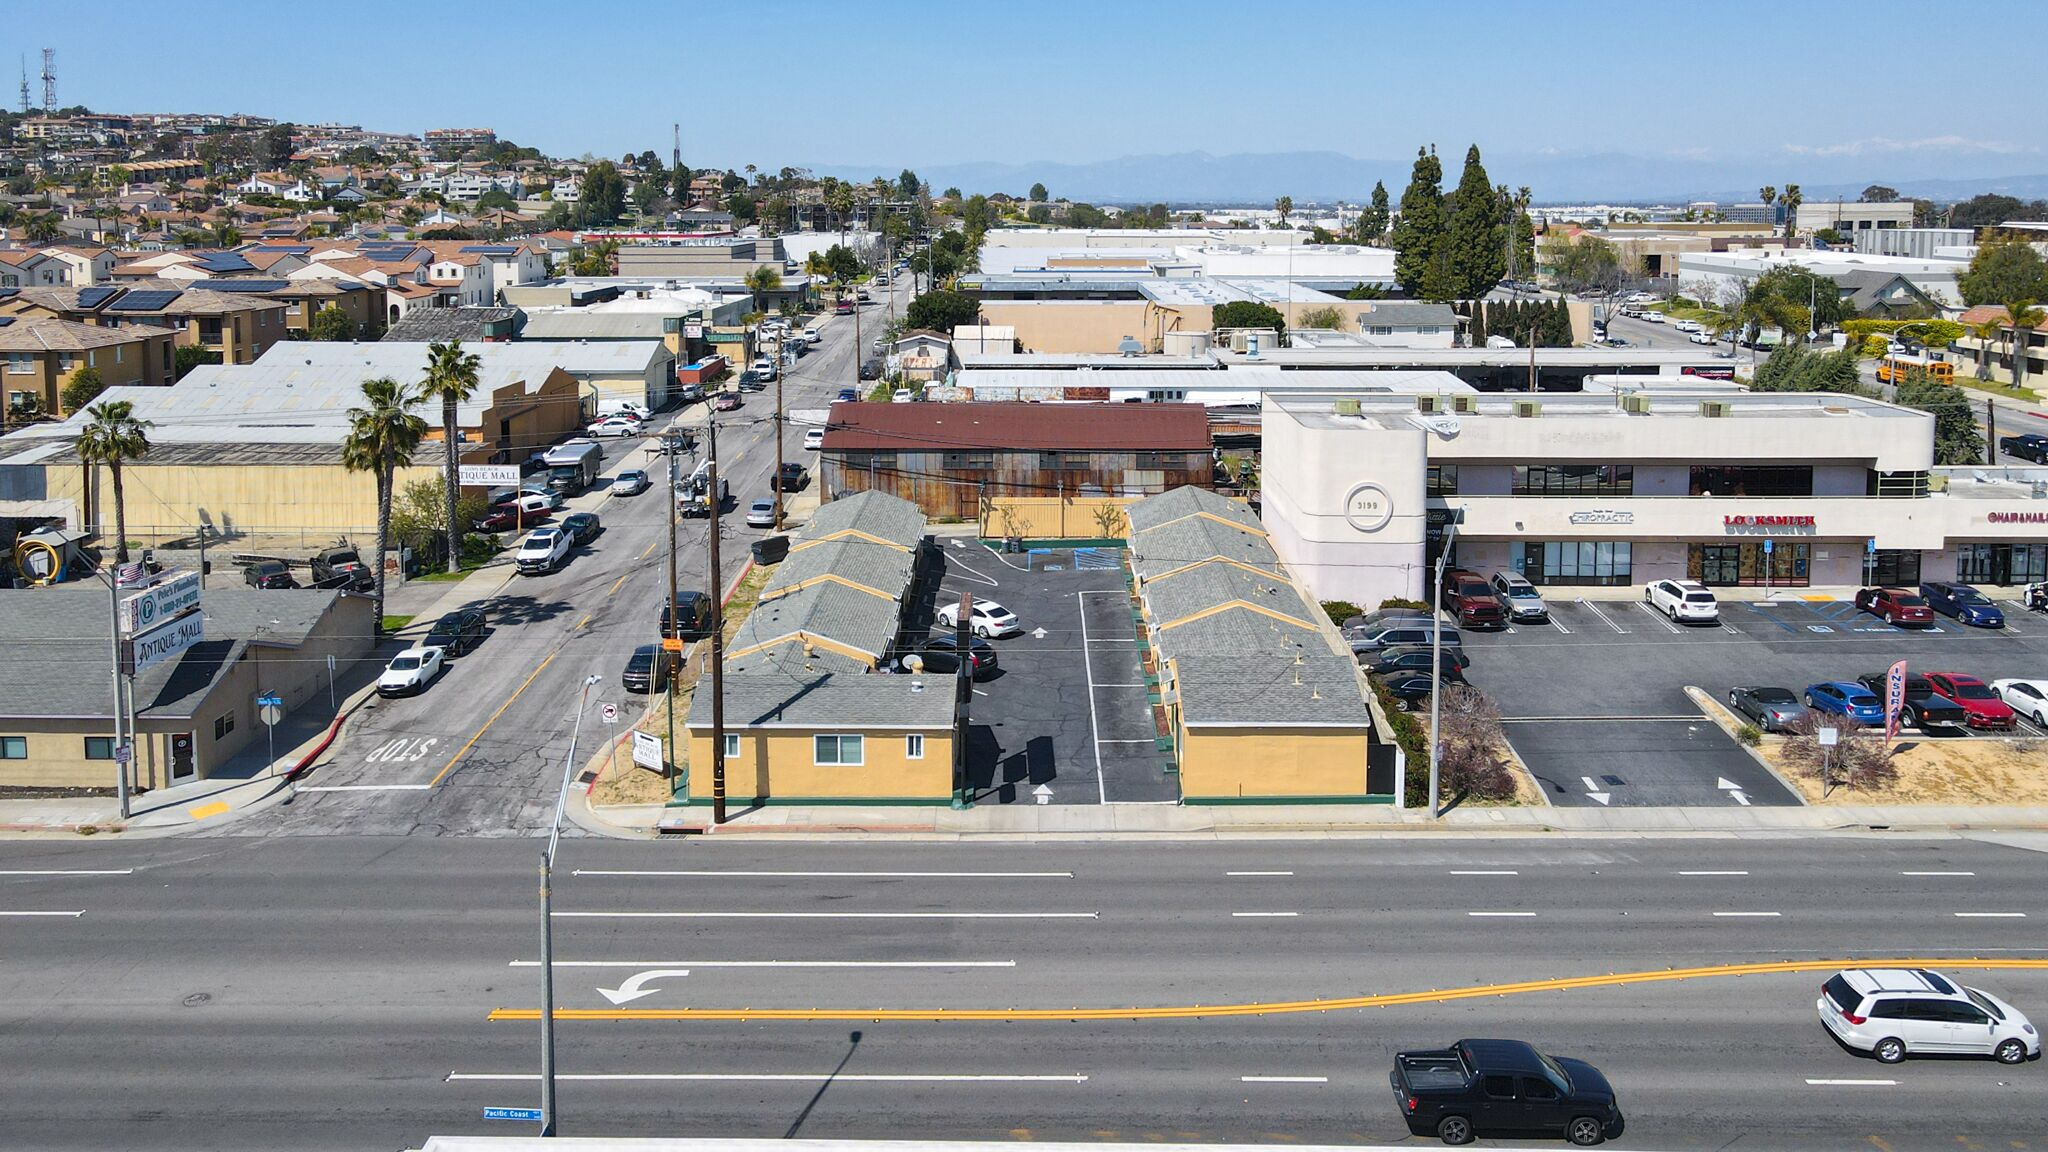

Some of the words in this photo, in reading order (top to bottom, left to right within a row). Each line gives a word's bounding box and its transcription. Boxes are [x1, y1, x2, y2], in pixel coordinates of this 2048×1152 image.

[459, 471, 488, 480] TIQUE
[491, 471, 518, 480] MALL
[1357, 502, 1378, 510] 3199
[1724, 515, 1816, 526] LOCKSMITH
[137, 632, 176, 667] ANTIQUE
[178, 621, 202, 647] MALL
[365, 738, 438, 762] STOP
[485, 1109, 508, 1117] Pacific
